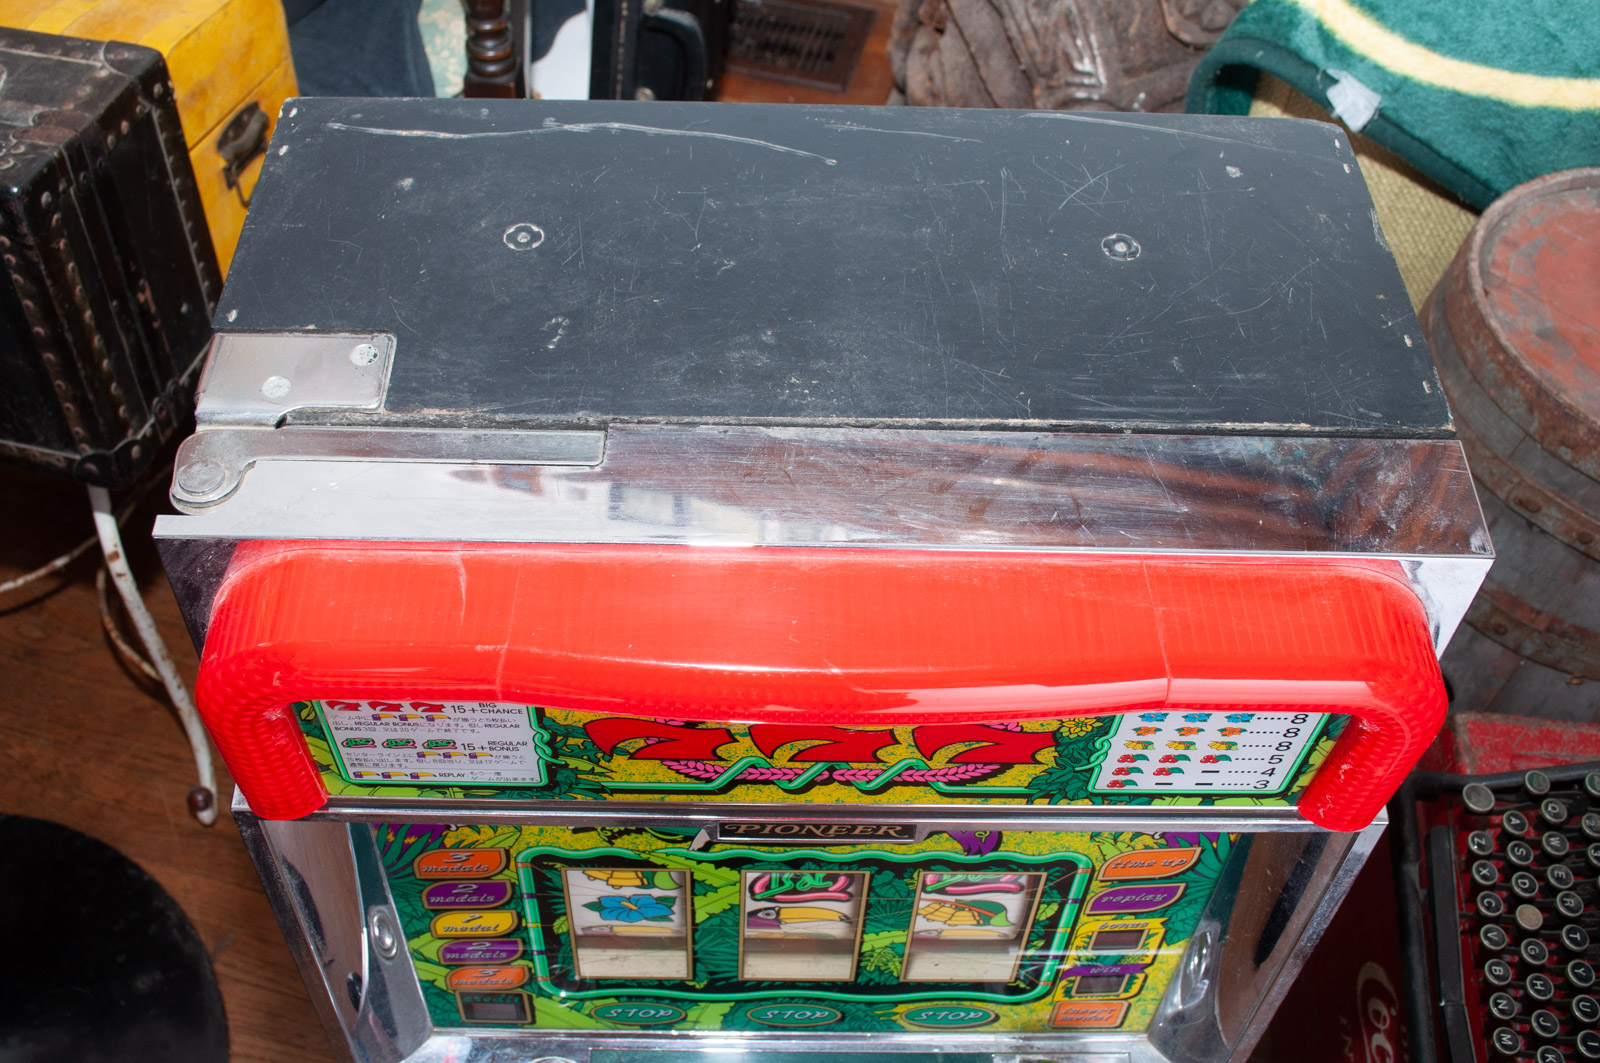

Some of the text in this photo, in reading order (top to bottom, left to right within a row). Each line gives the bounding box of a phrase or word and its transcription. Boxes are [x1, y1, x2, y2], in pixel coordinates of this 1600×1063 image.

[1290, 713, 1309, 724] 8
[1283, 727, 1300, 738] 8
[1275, 741, 1293, 751] 8
[1267, 754, 1284, 764] 5
[1260, 767, 1276, 777] 4
[1253, 780, 1270, 789] 3
[1548, 803, 1559, 813] Q
[1510, 816, 1520, 825] A
[724, 824, 909, 838] PIONEER
[1474, 837, 1485, 846] Z
[1548, 836, 1561, 847] W
[1514, 846, 1526, 857] S
[443, 852, 475, 863] 3
[421, 863, 490, 873] medals
[1112, 858, 1187, 869] time up
[1478, 867, 1490, 876] X
[1554, 870, 1566, 879] E
[452, 884, 479, 893] 2
[1518, 879, 1529, 889] D
[429, 893, 495, 903] medals
[1101, 893, 1168, 904] replay
[1483, 898, 1495, 907] C
[1562, 897, 1575, 907] R
[462, 914, 483, 923] 1
[442, 923, 500, 932] medal
[1097, 921, 1150, 930] bonus
[1486, 932, 1499, 940] V
[1569, 932, 1580, 940] T
[466, 942, 492, 951] 2
[1527, 945, 1539, 955] G
[445, 951, 508, 960] medals
[472, 968, 500, 978] 3
[1090, 966, 1121, 974] win
[1491, 965, 1503, 975] B
[1574, 967, 1586, 976] Y
[453, 976, 513, 985] medals
[1532, 980, 1545, 990] H
[463, 993, 521, 1003] credit
[1496, 999, 1509, 1009] N
[1579, 1001, 1591, 1012] U
[605, 1008, 673, 1018] STOP
[760, 1010, 829, 1020] STOP
[914, 1010, 984, 1020] STOP
[1062, 1006, 1117, 1015] insert
[1060, 1013, 1113, 1022] medal
[1539, 1017, 1551, 1027] J
[1500, 1033, 1513, 1045] M
[1544, 1053, 1557, 1063] K
